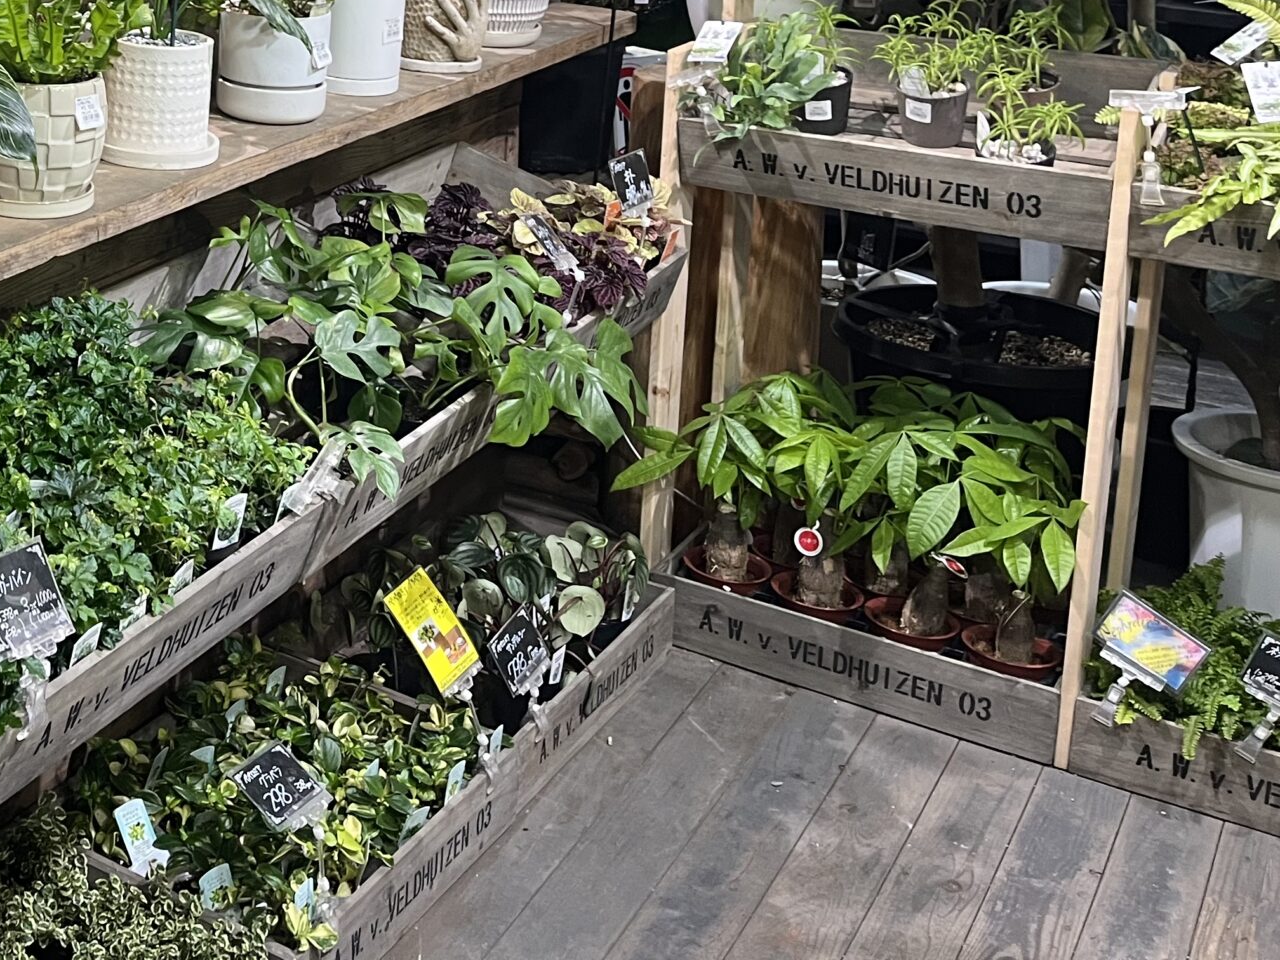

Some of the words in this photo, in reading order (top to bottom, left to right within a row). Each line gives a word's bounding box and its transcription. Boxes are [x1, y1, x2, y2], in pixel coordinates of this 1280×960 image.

[824, 161, 989, 211] VELDHUIZEN
[1006, 191, 1042, 219] 03
[121, 582, 244, 692] VELDHUIZEN
[248, 561, 277, 600] 03
[642, 634, 655, 664] 03
[787, 635, 945, 707] VELDHUIZEN
[958, 691, 993, 722] 03
[1136, 744, 1161, 772] A.
[263, 783, 293, 812] 298
[388, 825, 470, 923] VELDHUIZEN
[475, 800, 493, 832] 03
